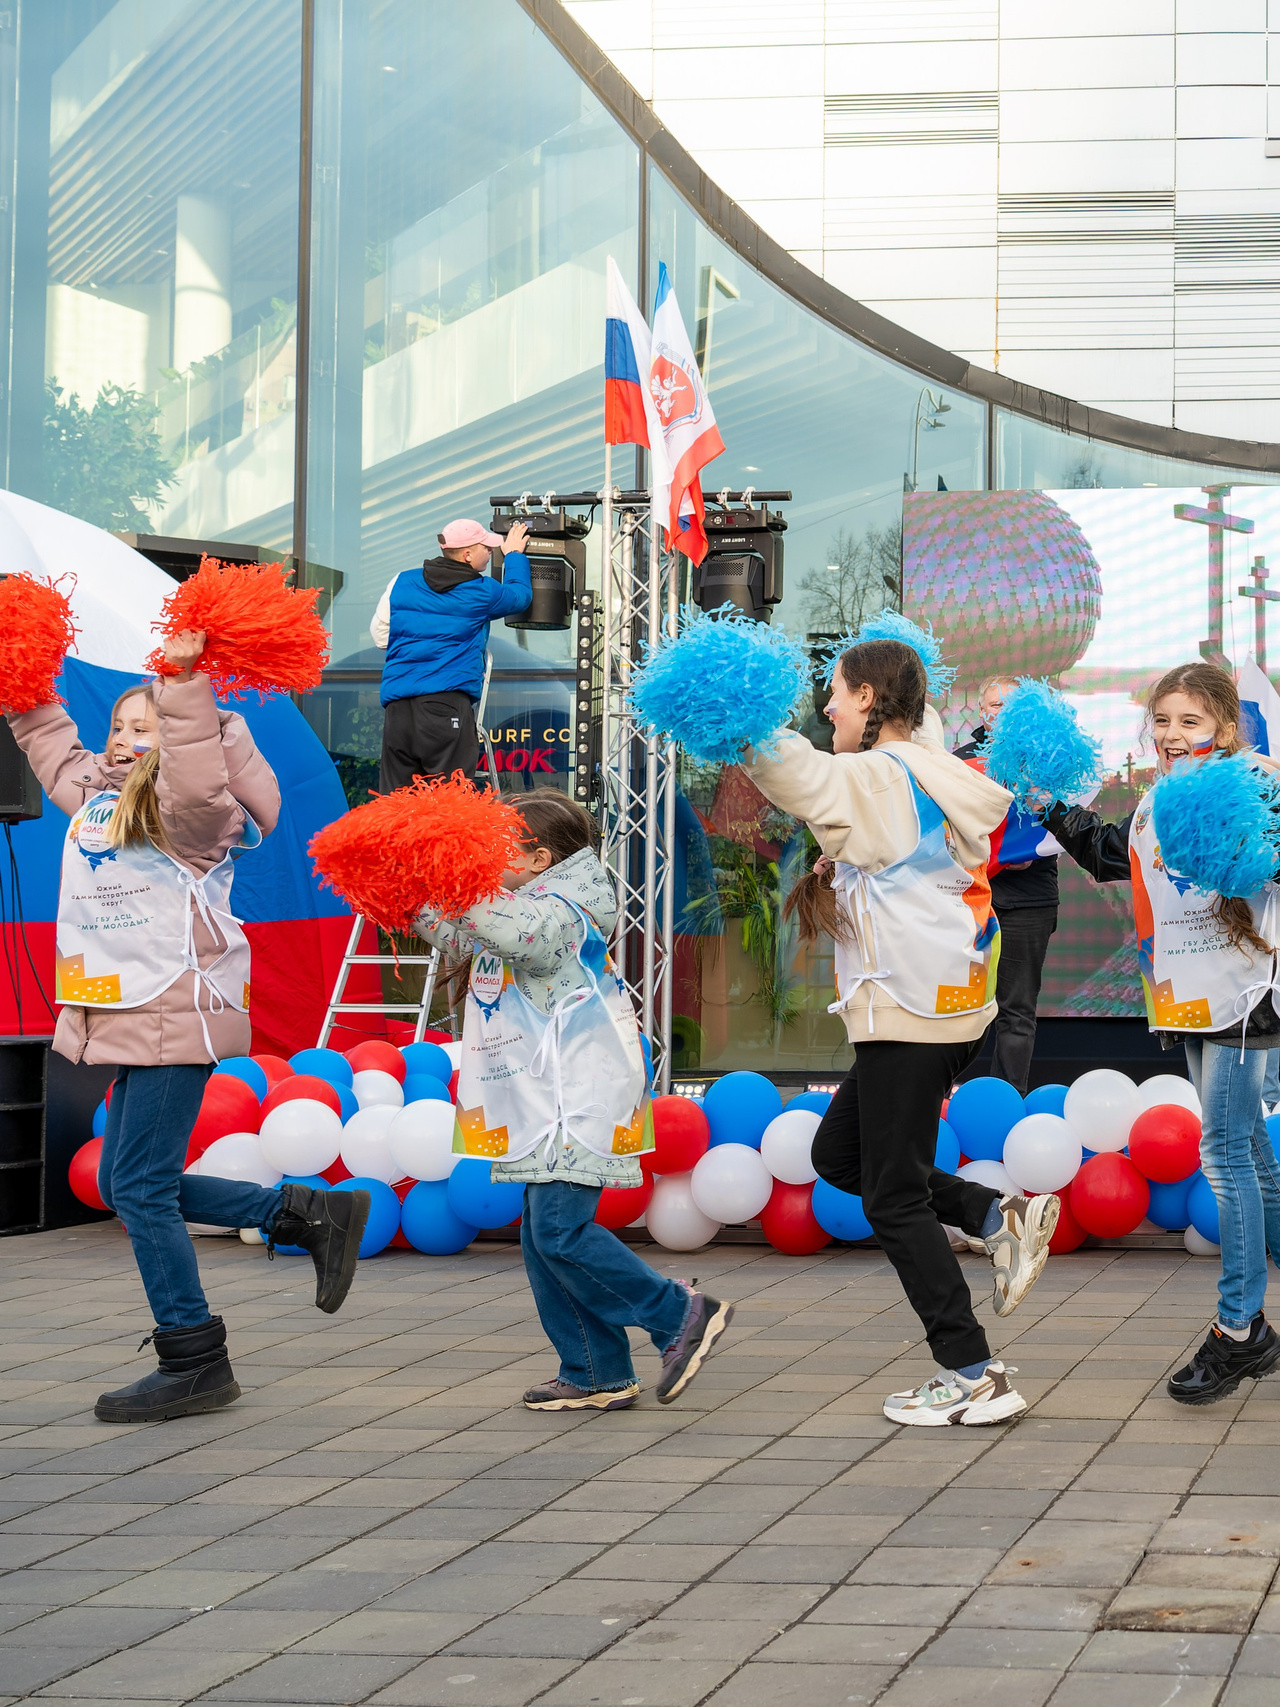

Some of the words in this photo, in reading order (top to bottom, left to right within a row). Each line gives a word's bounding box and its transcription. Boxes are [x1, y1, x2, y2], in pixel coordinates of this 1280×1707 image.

[86, 807, 114, 825] МИ
[96, 882, 122, 892] Южный
[71, 884, 151, 900] административный
[114, 913, 132, 921] ДСЦ
[1188, 922, 1212, 931] округ
[1202, 936, 1222, 945] ДСЦ
